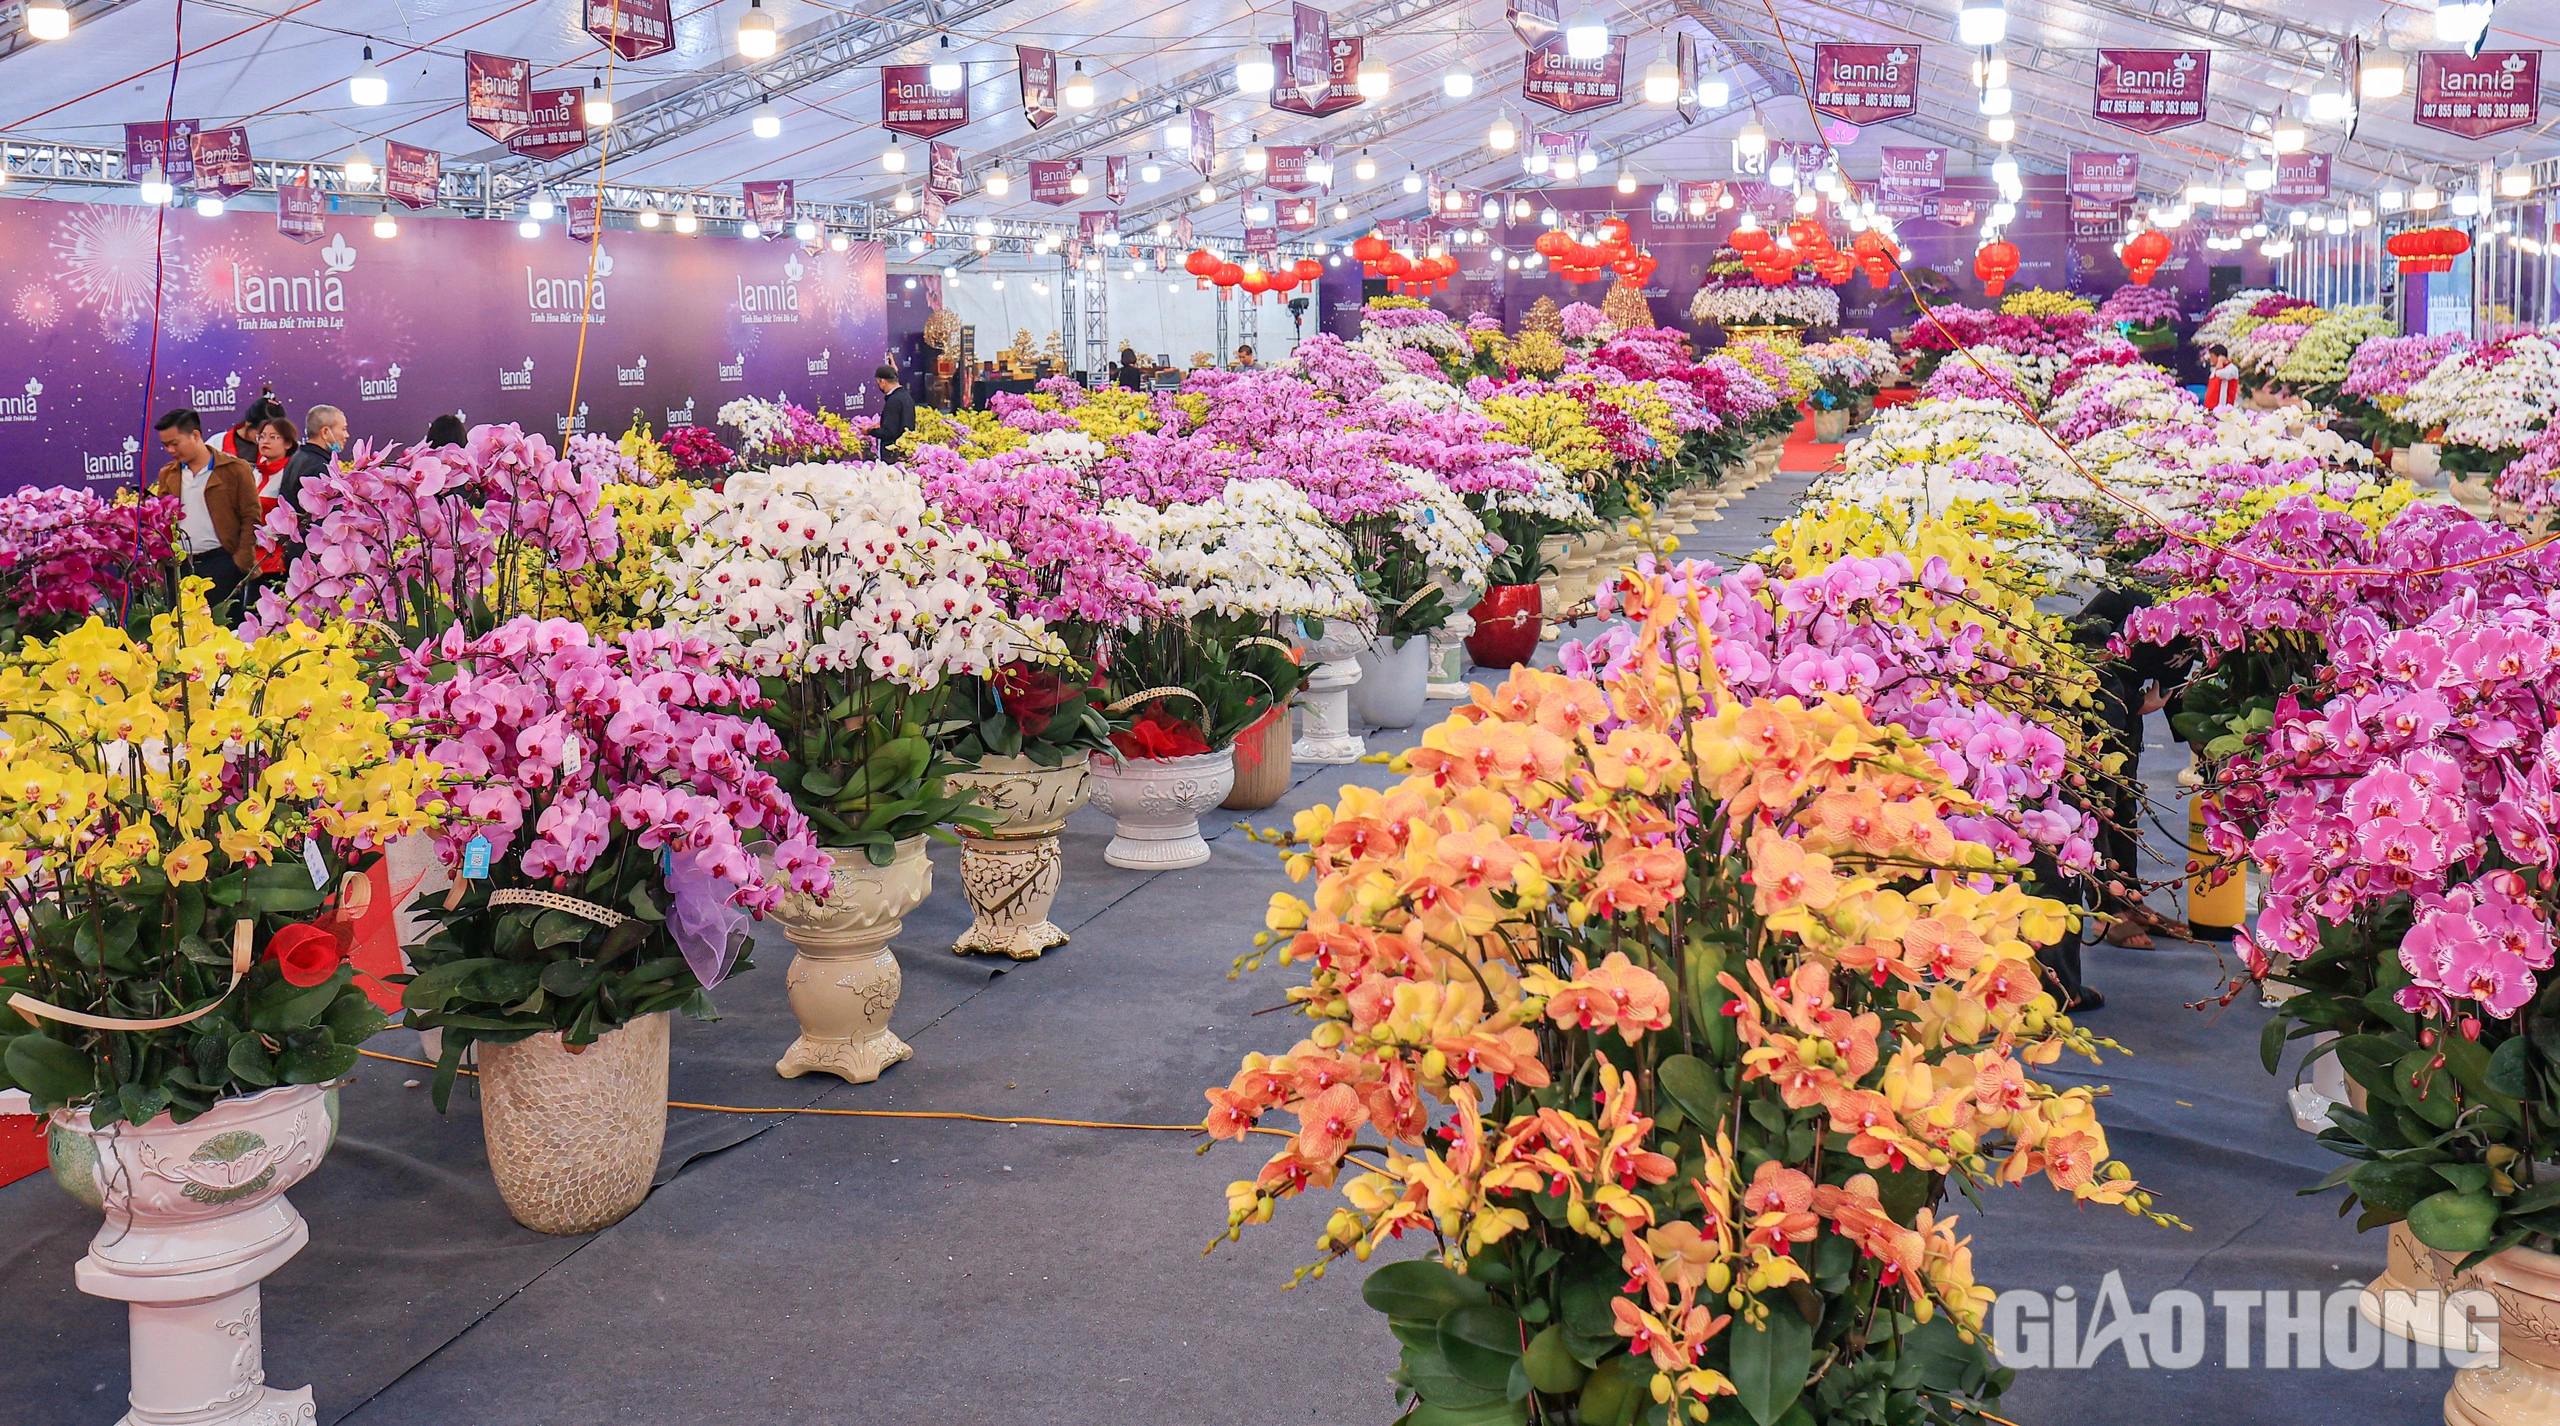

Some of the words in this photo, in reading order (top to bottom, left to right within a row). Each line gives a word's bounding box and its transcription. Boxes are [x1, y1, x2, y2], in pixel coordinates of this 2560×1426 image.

[1833, 58, 1898, 82] lannia
[2116, 64, 2185, 88] lannia
[2441, 66, 2514, 91] lannia
[481, 69, 519, 97] lannia
[1818, 92, 1830, 105] 087
[1832, 92, 1843, 106] 855
[1844, 93, 1860, 106] 6666
[1865, 93, 1878, 107] 085
[1880, 94, 1892, 108] 363
[1893, 94, 1911, 108] 9999
[2100, 99, 2113, 113] 087
[2114, 100, 2127, 113] 855
[2128, 100, 2145, 114] 6666
[2150, 100, 2164, 114] 085
[2165, 101, 2179, 115] 363
[2180, 101, 2199, 116] 9999
[530, 105, 570, 123] nnia
[2423, 103, 2437, 118] 087
[2438, 103, 2452, 118] 855
[2453, 103, 2471, 118] 6666
[2477, 103, 2492, 118] 085
[2493, 103, 2508, 118] 363
[2510, 103, 2530, 118] 9999
[201, 145, 240, 165] lannia
[1893, 156, 1933, 172] lannia
[1039, 169, 1073, 182] lannia
[2083, 162, 2124, 176] lannia
[2280, 165, 2317, 179] annia
[287, 196, 318, 214] lannia
[232, 262, 344, 314] lannia
[526, 265, 606, 311] lannia
[737, 274, 798, 312] lannia
[236, 317, 258, 330] Tinh
[260, 318, 277, 329] Hoa
[279, 315, 295, 329] Đất
[297, 317, 315, 329] Trời
[317, 316, 329, 329] Đà
[330, 317, 344, 330] Lạt
[572, 313, 585, 323] Trờ
[499, 367, 531, 386] lannia
[617, 364, 645, 381] lannia
[719, 361, 743, 377] lannia
[360, 376, 397, 395] lannia
[189, 384, 236, 406] lannia
[0, 394, 37, 415] nnia
[666, 406, 692, 423] lannia
[84, 451, 134, 474] lannia
